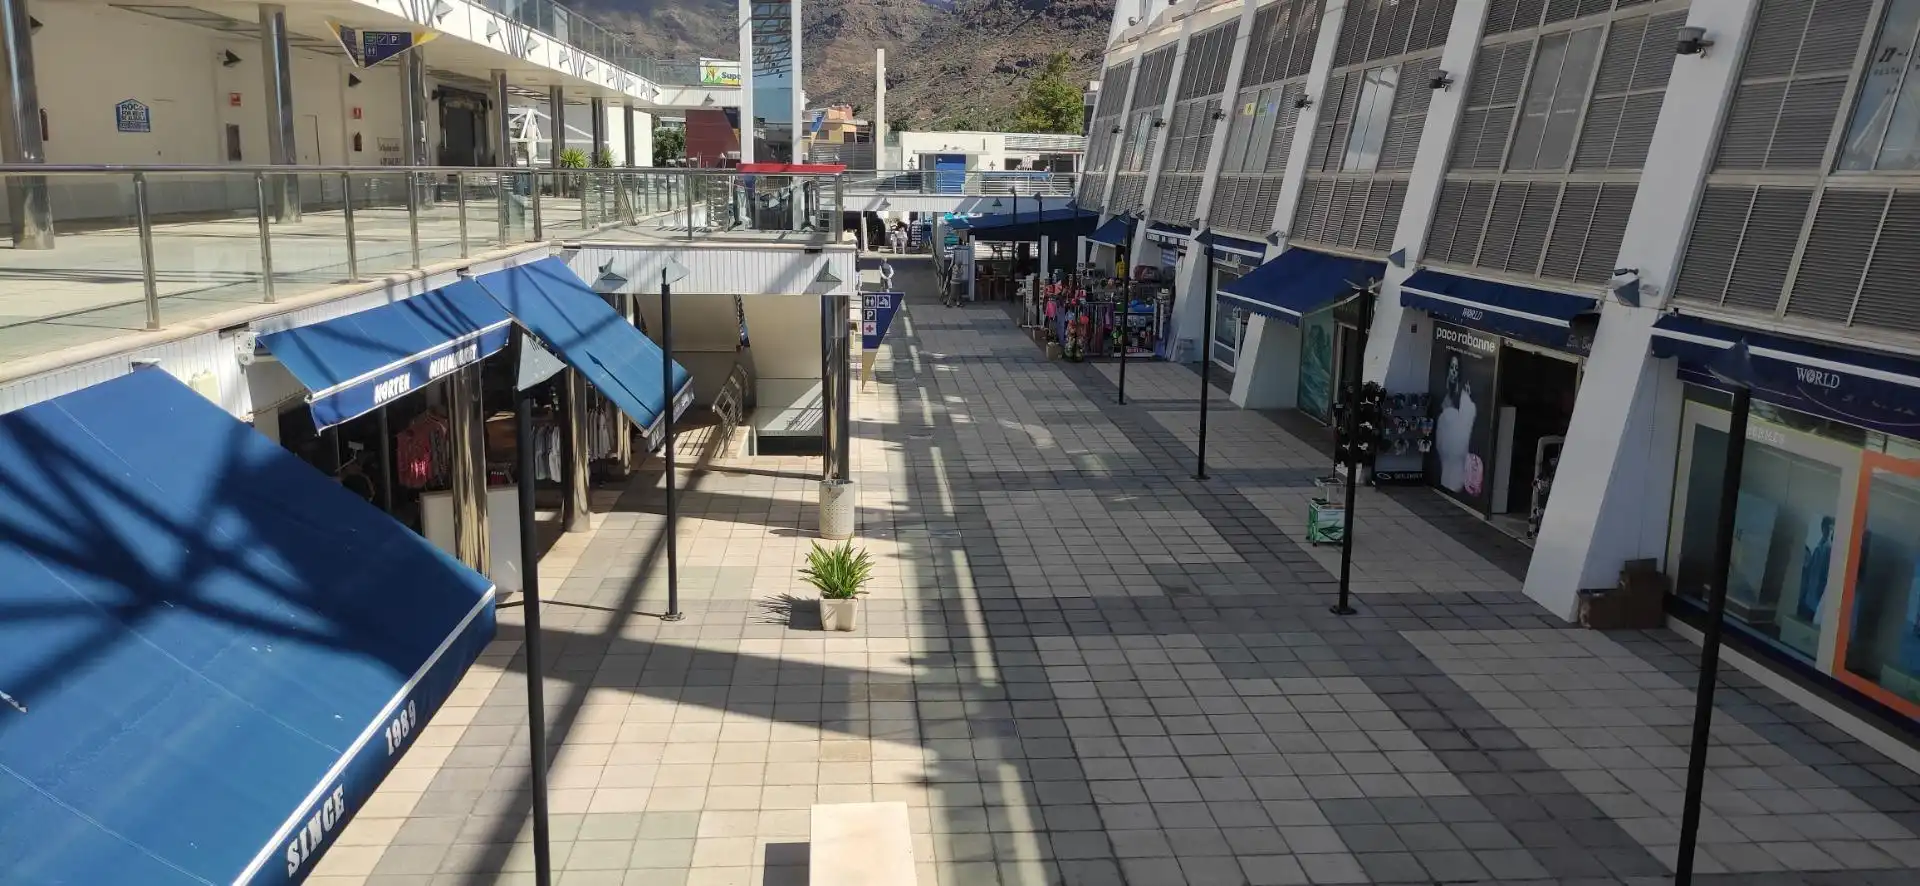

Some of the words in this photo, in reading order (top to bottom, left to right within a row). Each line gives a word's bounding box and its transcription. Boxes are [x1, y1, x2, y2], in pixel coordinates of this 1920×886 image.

[866, 310, 874, 320] P
[1436, 327, 1457, 342] paco
[1457, 332, 1496, 353] rabanne
[1796, 366, 1840, 389] WORLD
[287, 784, 345, 878] SINCE
[385, 699, 416, 756] 1989
